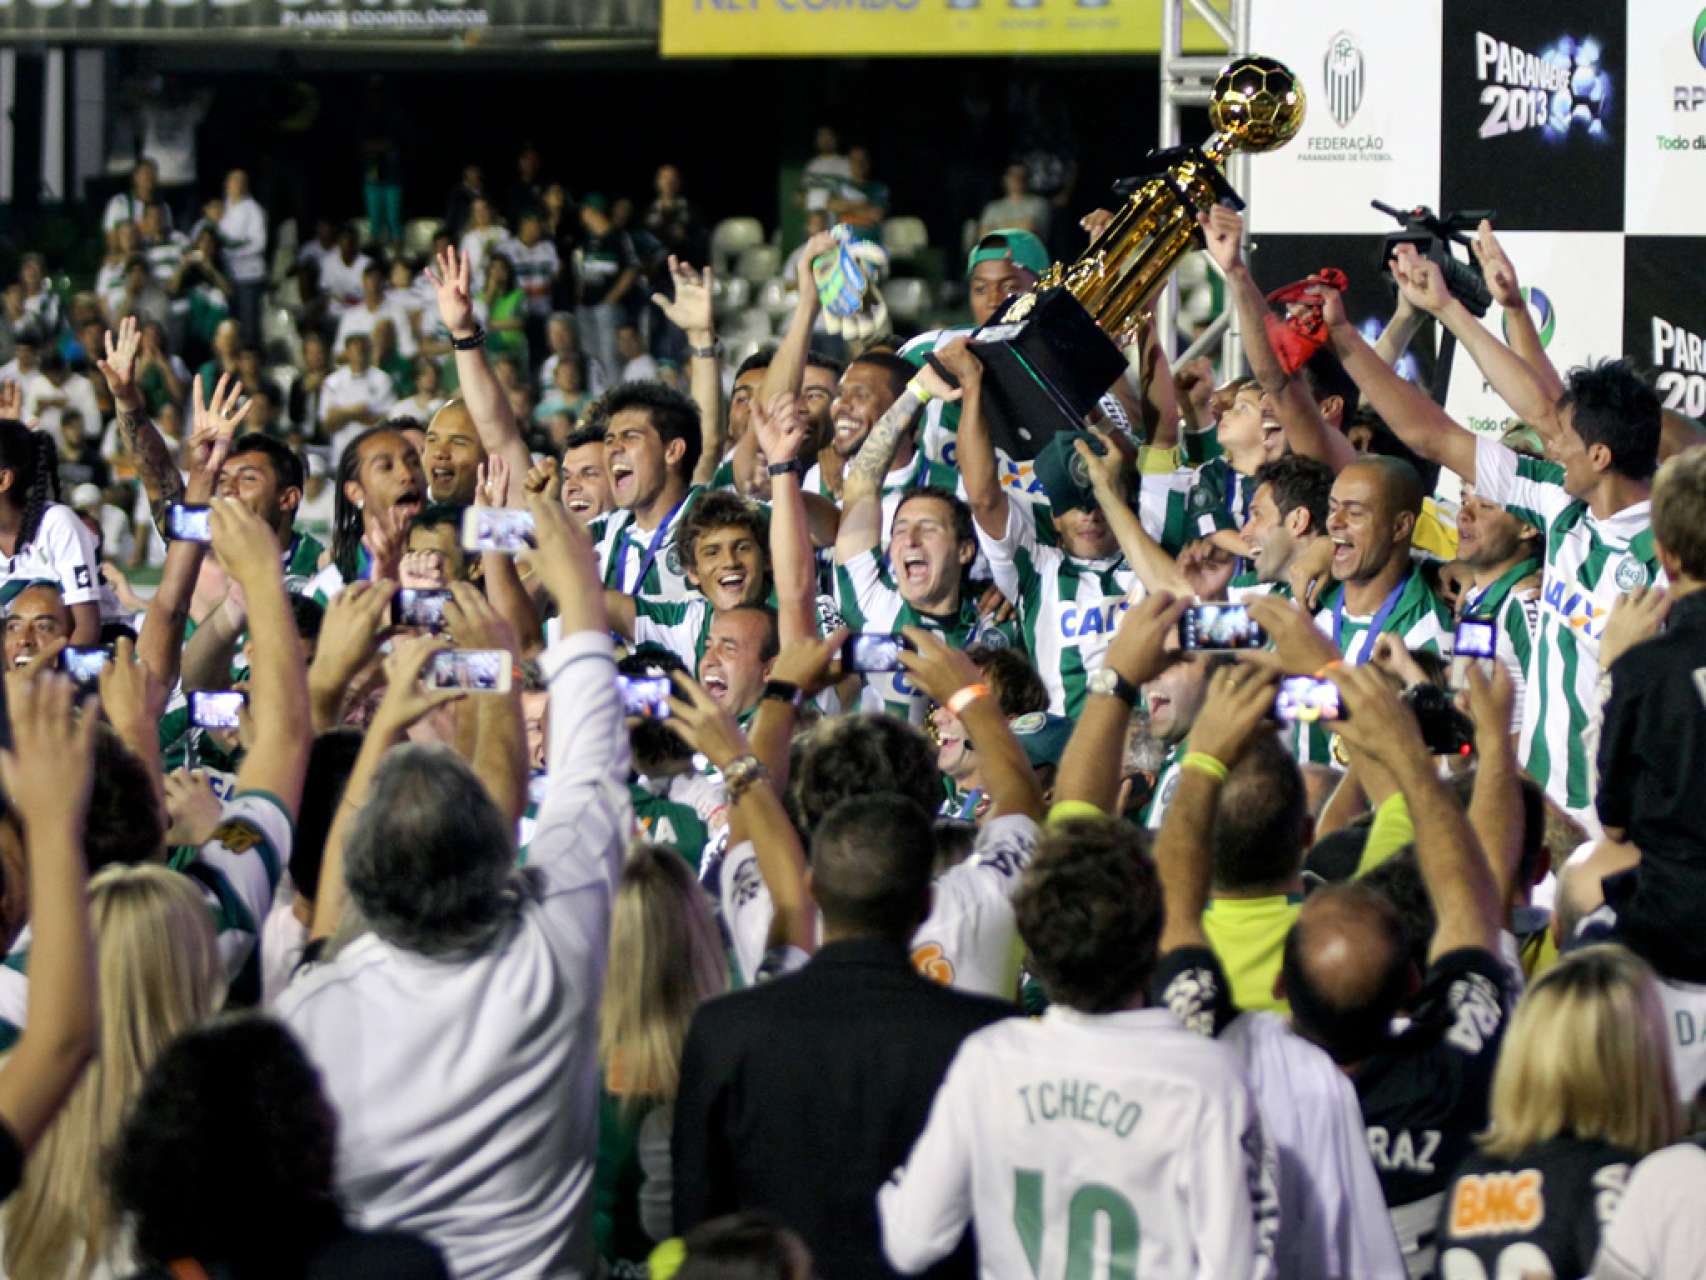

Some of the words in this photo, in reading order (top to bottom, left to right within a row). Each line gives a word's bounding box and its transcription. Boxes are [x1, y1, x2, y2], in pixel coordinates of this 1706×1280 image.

[1480, 84, 1548, 139] 2013
[1307, 135, 1384, 154] FEDERAÇÃO
[1656, 134, 1690, 150] Todo
[1652, 315, 1706, 373] PAR
[1655, 370, 1706, 418] 20
[1467, 416, 1498, 431] Todo
[1060, 601, 1129, 638] CAI
[1018, 1078, 1143, 1139] TCHECO
[1366, 1125, 1441, 1172] RAZ
[1450, 1169, 1543, 1238] BMG
